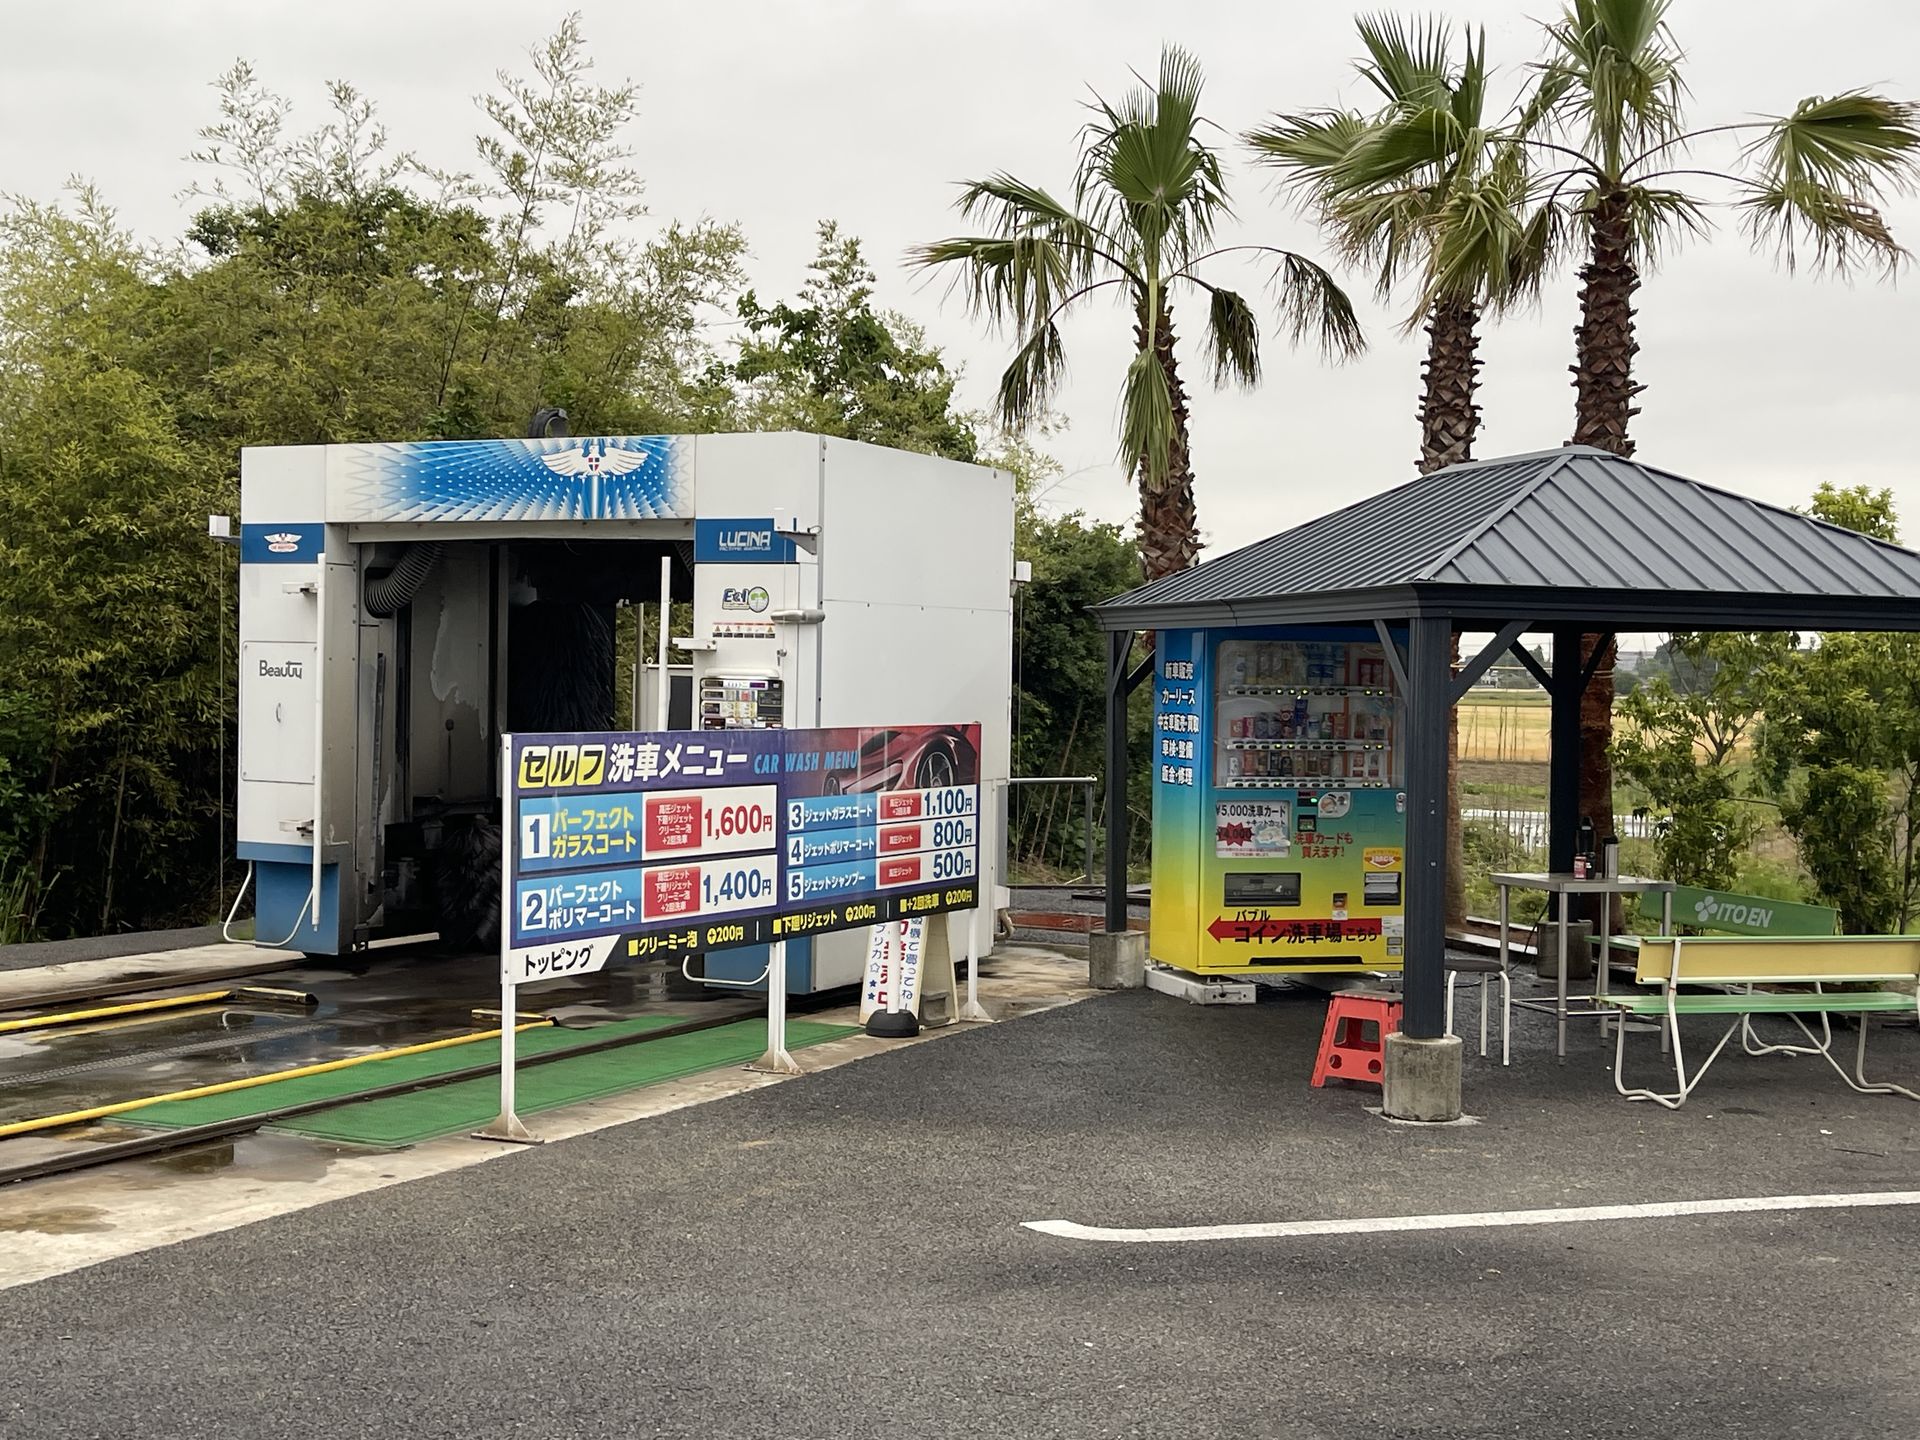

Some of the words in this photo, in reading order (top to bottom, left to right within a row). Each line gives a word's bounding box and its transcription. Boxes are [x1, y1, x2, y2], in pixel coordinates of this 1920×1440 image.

[719, 531, 771, 547] LUCINA
[259, 660, 302, 679] Beauty
[1161, 687, 1196, 705] カーリース
[754, 753, 779, 774] CAR
[785, 751, 819, 772] WASH
[823, 750, 859, 770] MENU
[804, 804, 873, 823] ジェットガラスコート
[924, 788, 973, 816] 1,100円
[552, 807, 634, 833] パーフェクト
[704, 804, 773, 840] 1,600円
[933, 819, 973, 847] 800円
[552, 830, 637, 858] ガラスコート
[804, 836, 875, 857] ジェットポリマーコート
[1294, 832, 1353, 845] 洗車カードも
[932, 851, 972, 879] 500円
[549, 880, 622, 907] パーフェクト
[703, 868, 772, 906] 1,400円
[804, 873, 866, 892] ジェットシャンプー
[548, 900, 636, 931] ポリマーコート
[1235, 909, 1270, 922] バブル
[525, 943, 594, 977] トッピング
